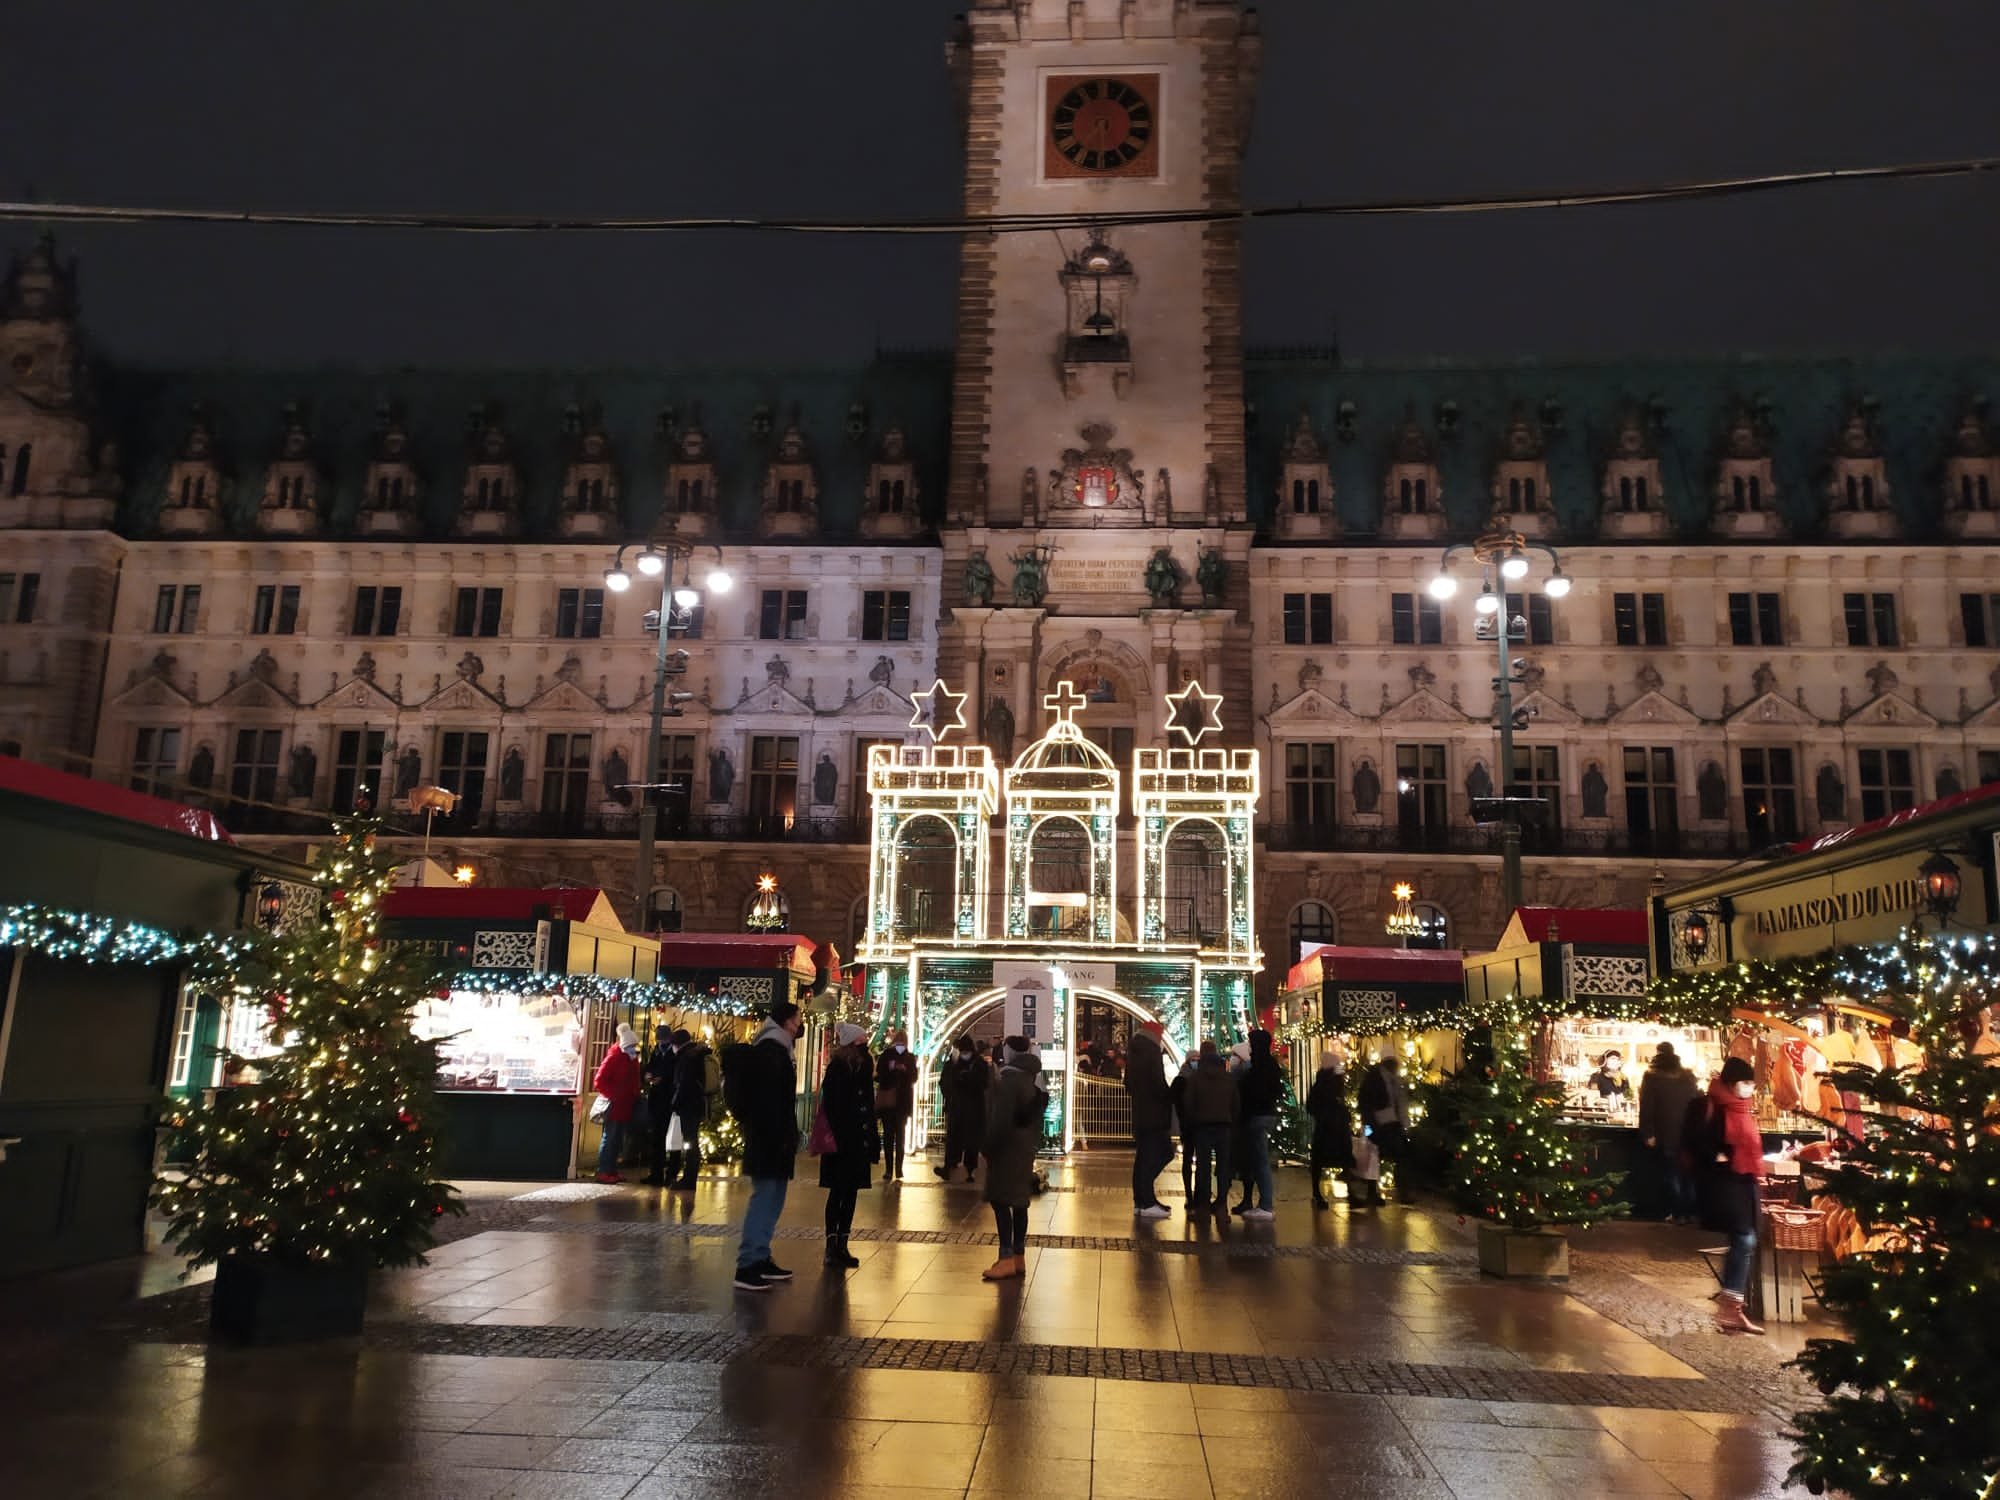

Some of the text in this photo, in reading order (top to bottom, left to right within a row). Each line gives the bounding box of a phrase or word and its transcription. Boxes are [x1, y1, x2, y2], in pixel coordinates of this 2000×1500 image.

[1755, 909, 1778, 935] LA
[1778, 892, 1848, 933] MAISON
[1851, 886, 1879, 917] DU
